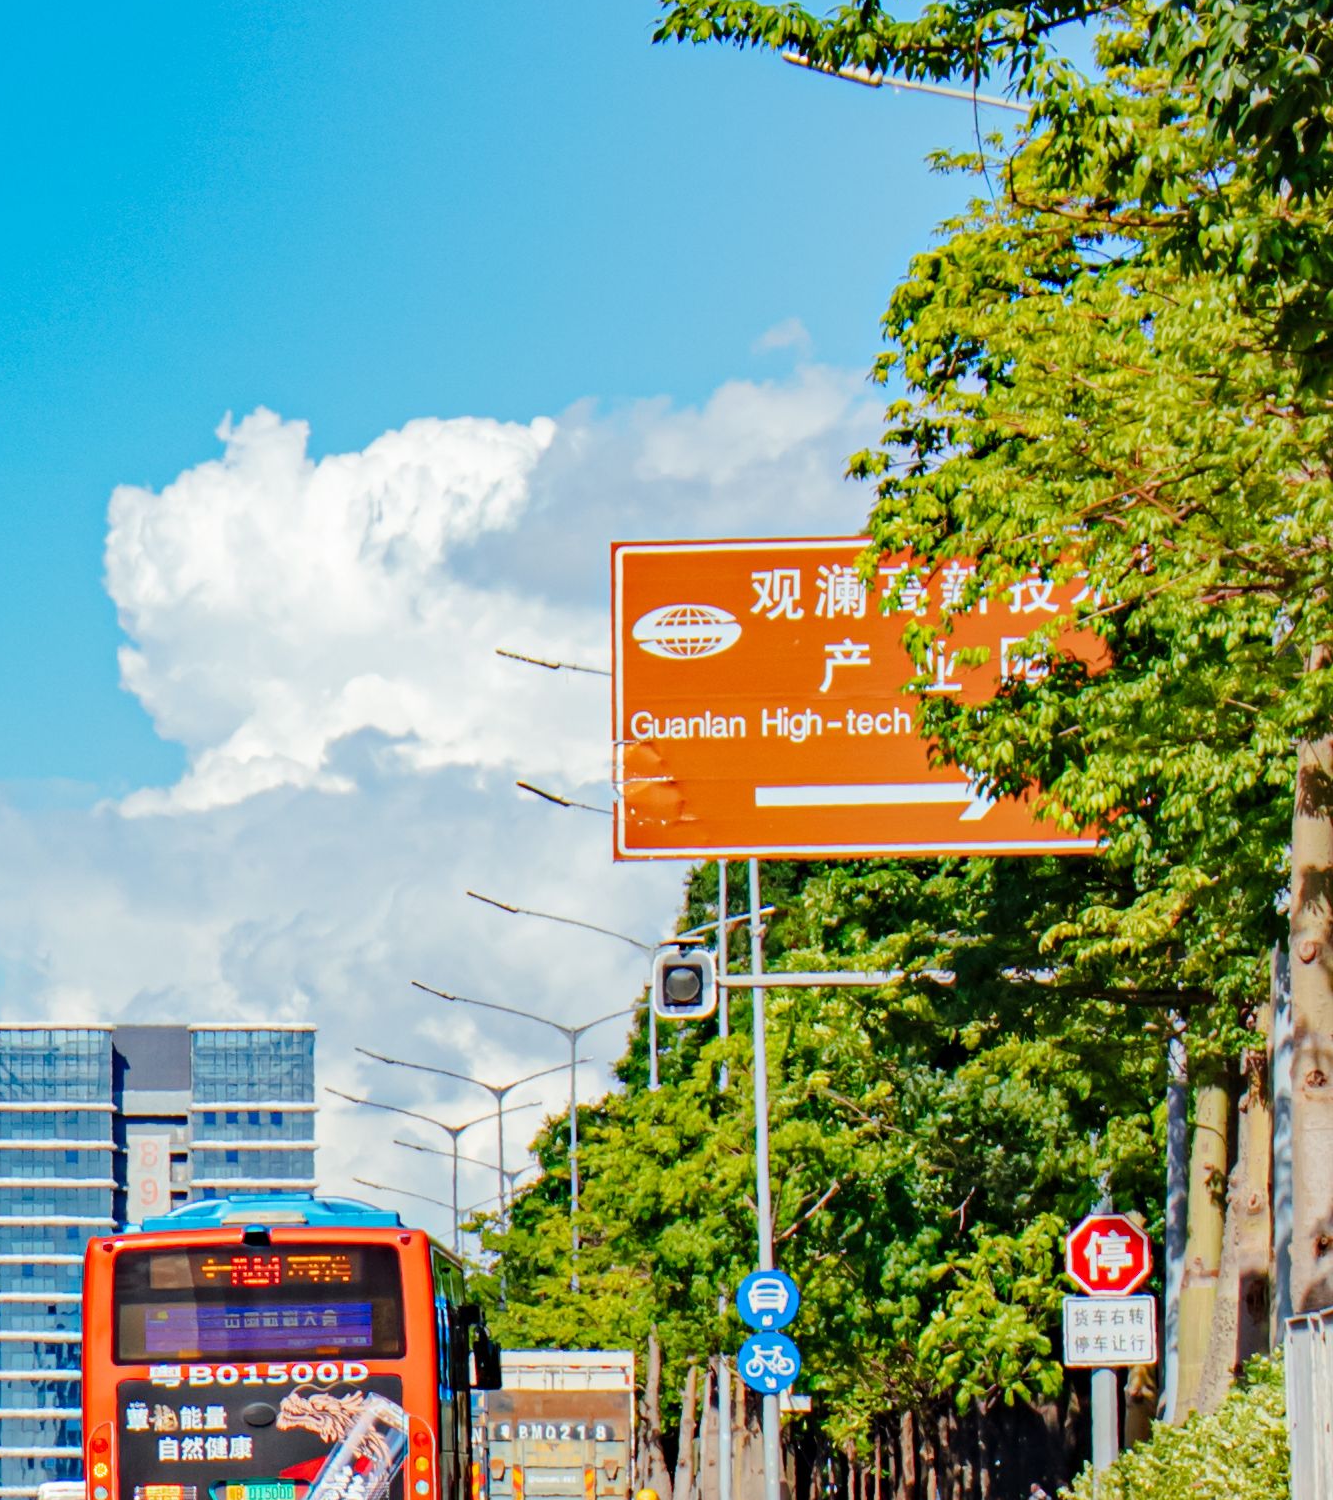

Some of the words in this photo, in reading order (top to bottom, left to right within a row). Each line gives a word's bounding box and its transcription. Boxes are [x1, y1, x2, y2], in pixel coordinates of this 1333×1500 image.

[630, 710, 746, 740] Guanlan
[761, 706, 912, 743] High-tech
[1083, 1229, 1133, 1281] 停
[1074, 1308, 1146, 1327] 货车右转
[1074, 1333, 1146, 1353] 停车让行
[148, 1362, 369, 1388] 粤B01500D
[158, 1435, 253, 1461] 自然健康
